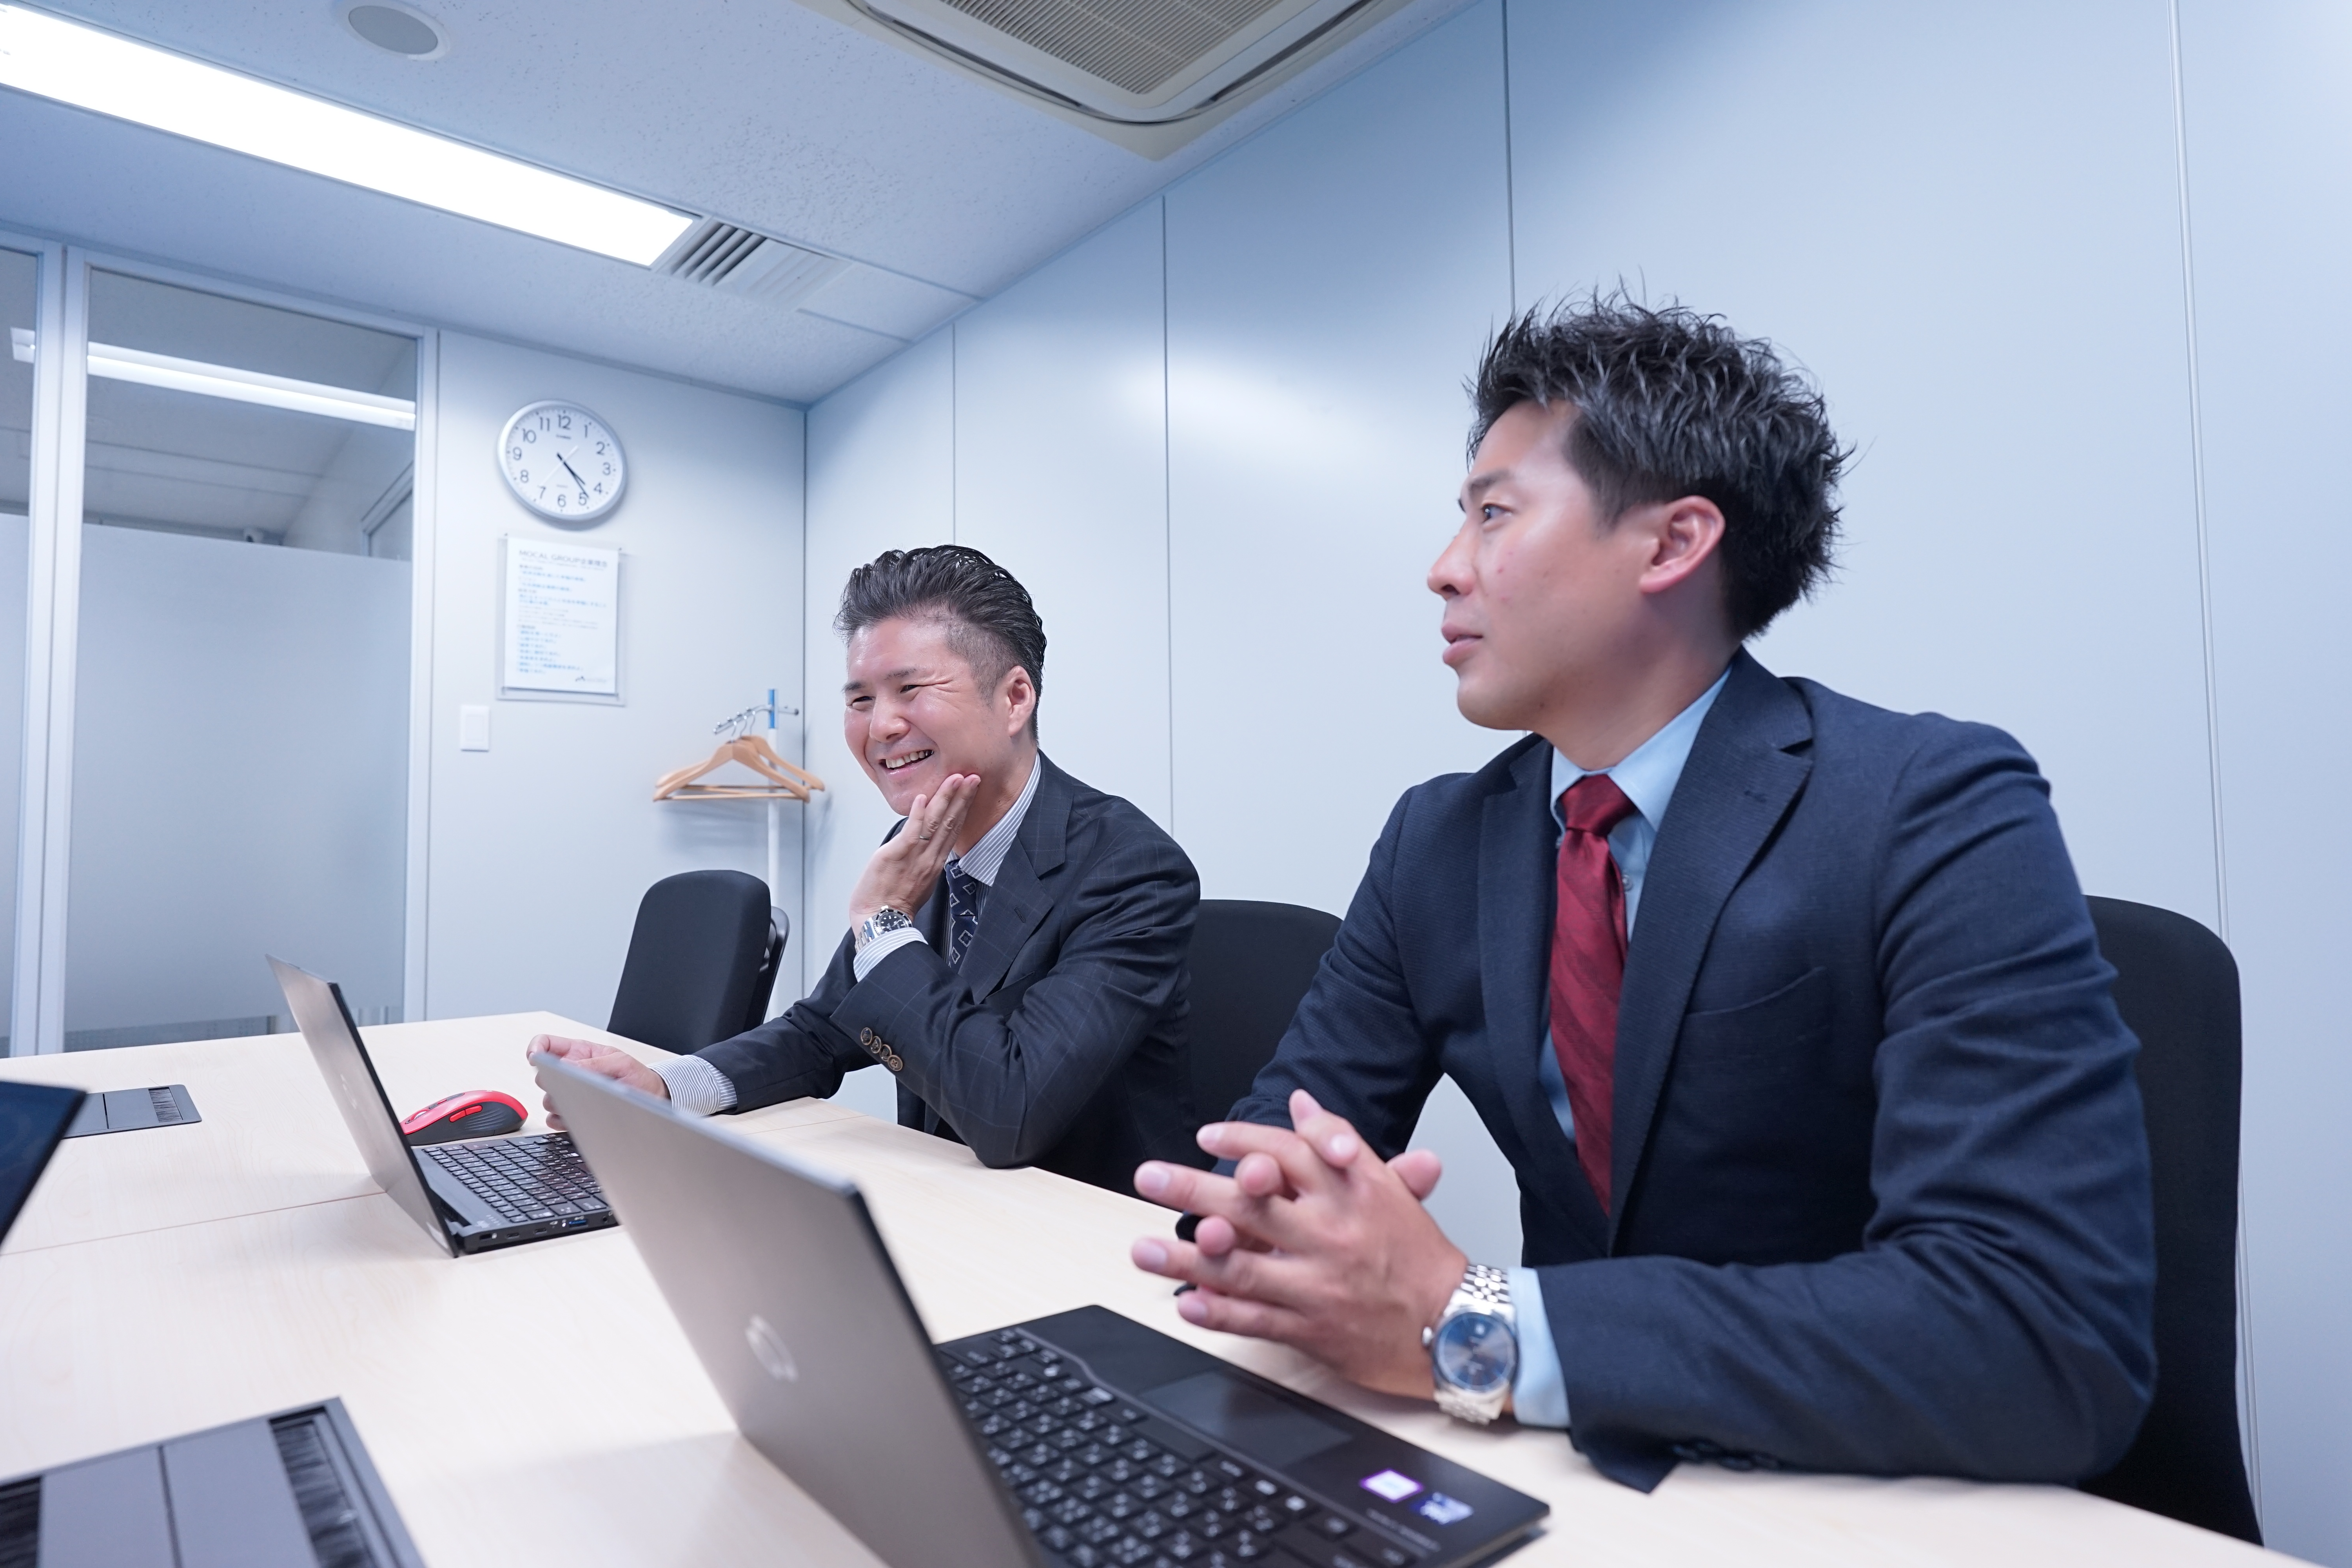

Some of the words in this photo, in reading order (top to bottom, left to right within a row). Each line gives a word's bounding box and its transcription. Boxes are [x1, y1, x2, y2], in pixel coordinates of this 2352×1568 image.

[540, 416, 550, 431] 11
[558, 414, 571, 430] 12
[522, 428, 536, 443] 10
[584, 424, 588, 438] 1
[513, 447, 521, 461] 9
[596, 441, 605, 456] 2
[602, 462, 611, 475] 3
[520, 470, 529, 483] 8
[538, 485, 546, 499] 7
[593, 482, 602, 495] 4
[557, 494, 566, 507] 6
[578, 492, 587, 506] 5
